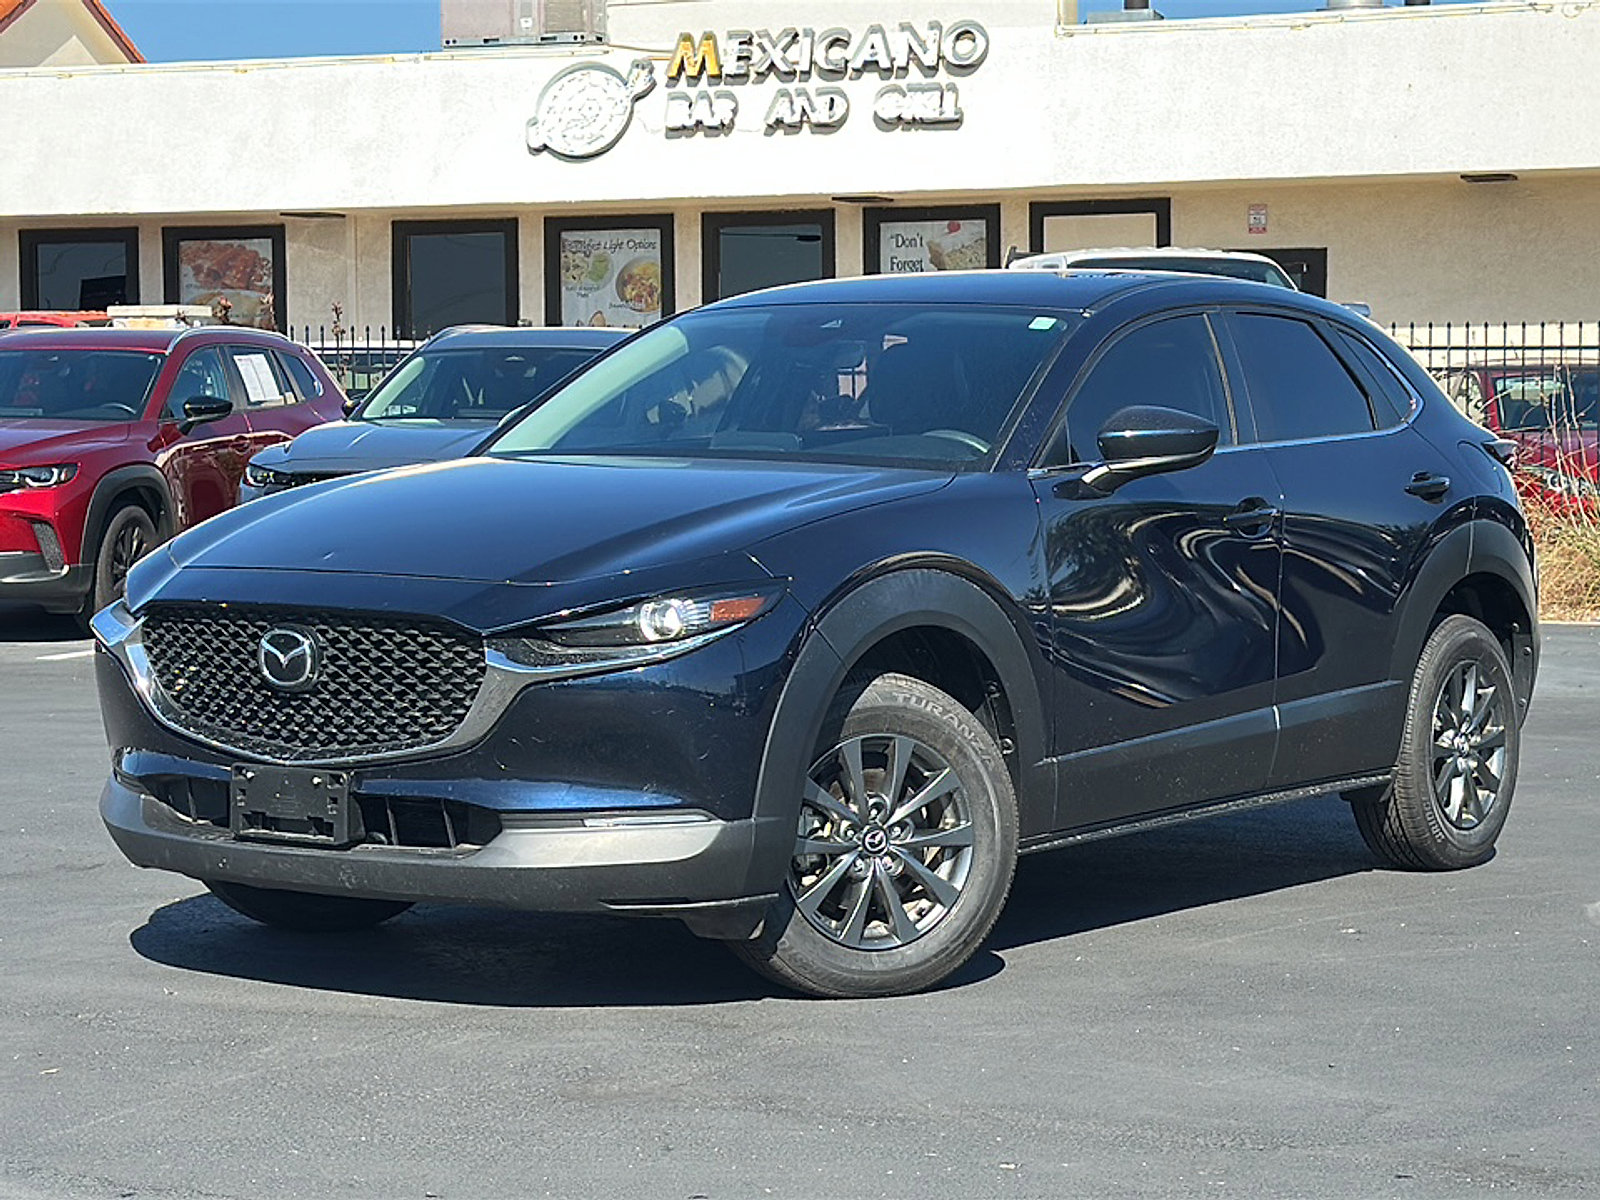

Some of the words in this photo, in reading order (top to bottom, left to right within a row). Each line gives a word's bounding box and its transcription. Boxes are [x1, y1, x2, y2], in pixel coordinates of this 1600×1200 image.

[665, 19, 989, 87] MEXICANO
[665, 90, 738, 139] BAR
[763, 86, 850, 136] AND
